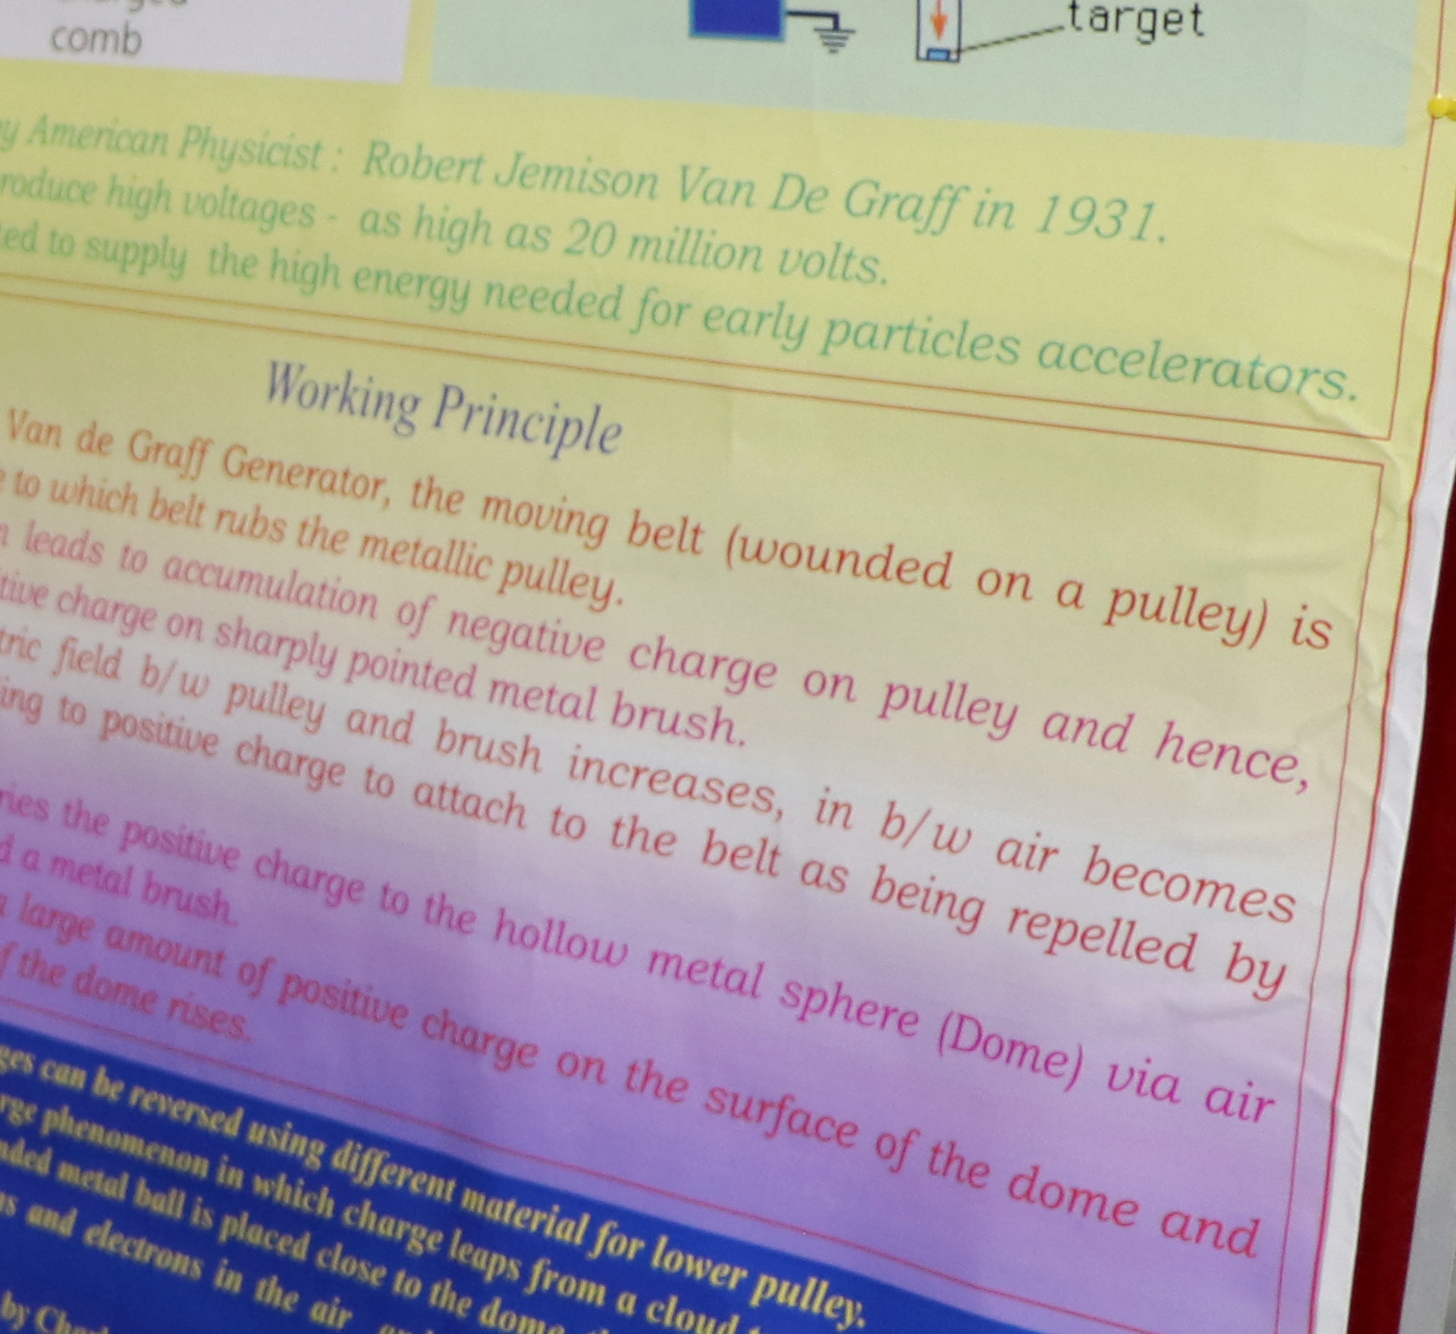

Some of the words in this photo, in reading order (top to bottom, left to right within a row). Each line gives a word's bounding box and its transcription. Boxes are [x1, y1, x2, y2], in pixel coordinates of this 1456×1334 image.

[52, 22, 142, 57] comb
[27, 114, 169, 158] American
[178, 124, 324, 172] Physicist
[362, 140, 485, 184] Robert
[494, 151, 659, 200] Jemison
[677, 164, 756, 209] Van
[771, 171, 829, 219] De
[844, 177, 970, 236] Graff
[974, 187, 1016, 230] in
[1035, 194, 1167, 244] 1931.
[107, 176, 172, 221] high
[183, 185, 316, 234] voltages
[360, 208, 402, 235] as
[414, 203, 492, 254] high
[505, 223, 551, 254] as
[563, 219, 617, 257] 20
[629, 226, 763, 274] million
[778, 240, 888, 286] volts.
[50, 225, 75, 257] to
[85, 230, 187, 278] supply
[209, 243, 258, 278] the
[270, 247, 341, 298] high
[353, 265, 471, 315] energy
[484, 275, 625, 321] needed
[631, 287, 693, 335] for
[703, 301, 810, 353] early
[819, 314, 1021, 363] particles
[1038, 338, 1358, 402] accelerators.
[266, 359, 422, 435] Working
[434, 382, 623, 461] Principle
[9, 408, 62, 449] Van
[77, 420, 113, 457] de
[129, 429, 214, 481] Graff
[222, 443, 390, 510] Generator,
[412, 475, 465, 516] the
[482, 494, 610, 552] moving
[628, 509, 705, 556] belt
[726, 524, 954, 590] (wounded
[977, 568, 1033, 602] on
[1057, 578, 1085, 609] a
[1103, 585, 1269, 650] pulley)
[1291, 603, 1333, 650] is
[25, 520, 105, 566] leads
[122, 544, 147, 574] to
[162, 553, 378, 620] accumulation
[396, 594, 437, 638] of
[448, 606, 606, 663] negative
[629, 635, 779, 694] charge
[804, 667, 857, 703] on
[878, 679, 1019, 742] pulley
[1043, 713, 1136, 754] and
[1155, 721, 1309, 796] hence,
[58, 584, 158, 638] charge
[166, 609, 204, 641] on
[215, 617, 339, 678] sharply
[345, 649, 478, 699] pointed
[489, 677, 598, 722] metal
[611, 689, 746, 748] brush.
[253, 848, 365, 907] charge
[380, 881, 410, 916] to
[424, 891, 478, 936] the
[494, 907, 629, 967] hollow
[648, 946, 767, 1000] metal
[780, 978, 920, 1038] sphere
[938, 1010, 1084, 1092] (Dome)
[1107, 1057, 1182, 1105] via
[1205, 1081, 1277, 1124] air
[246, 1121, 327, 1170] using
[332, 1140, 457, 1202] different
[461, 1186, 591, 1245] material
[587, 1221, 646, 1259] for
[651, 1235, 748, 1290] lower
[751, 1273, 866, 1331] pulley.
[341, 1199, 444, 1256] charge
[449, 1228, 522, 1283] leaps
[525, 1258, 607, 1306] from
[616, 1290, 637, 1316] a
[0, 1290, 30, 1330] by
